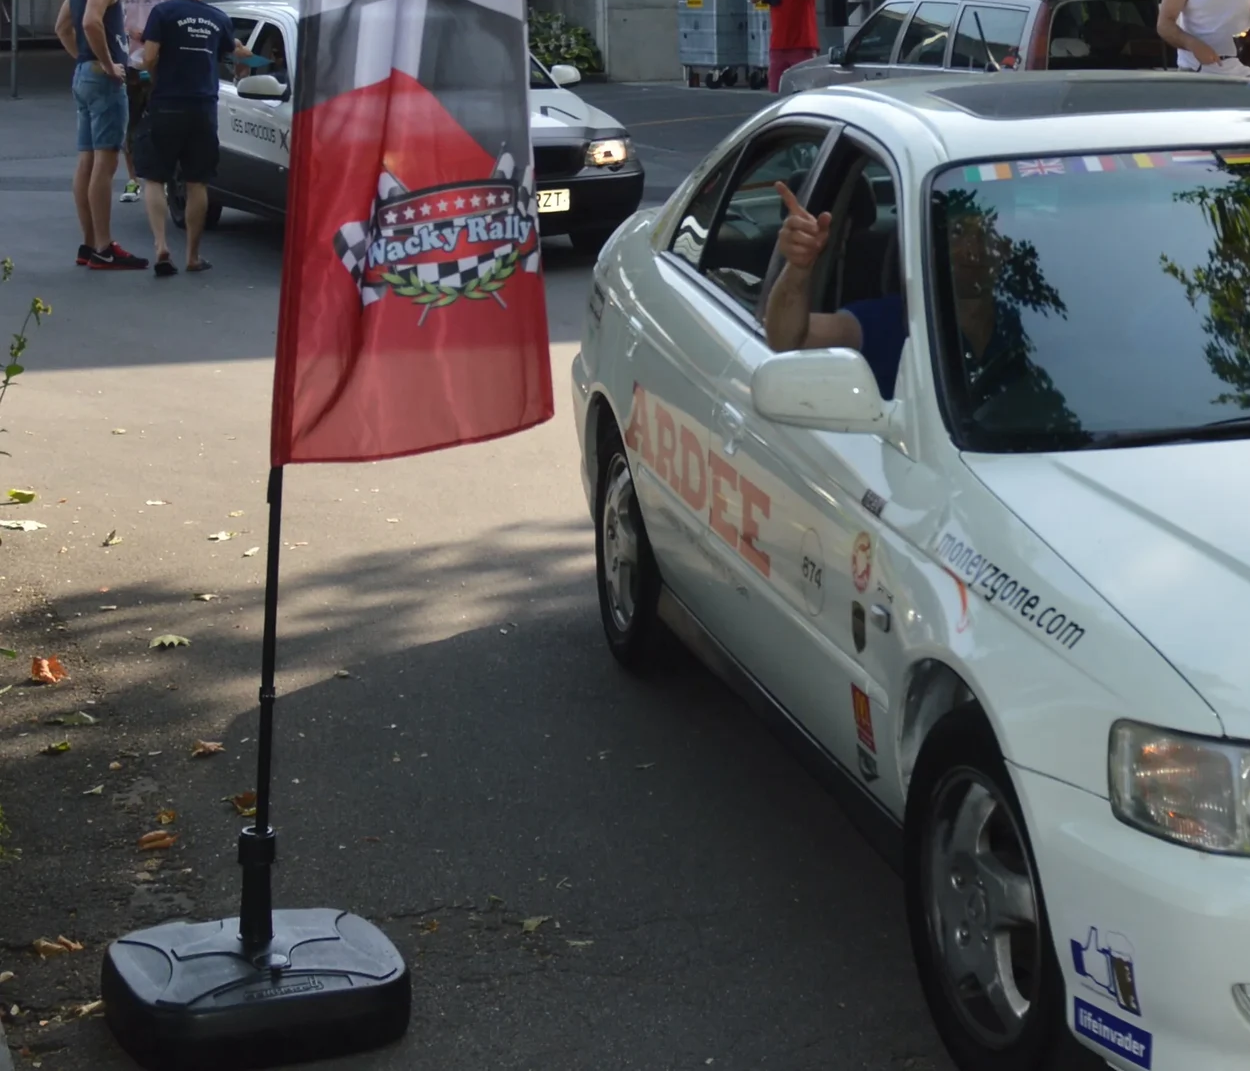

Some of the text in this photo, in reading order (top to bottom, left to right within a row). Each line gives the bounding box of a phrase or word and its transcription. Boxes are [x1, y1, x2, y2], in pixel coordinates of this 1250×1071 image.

[367, 214, 533, 269] Wacky Rally
[624, 380, 771, 579] ARDEE
[935, 532, 1087, 650] moneyzgone.com
[1078, 1007, 1146, 1058] lifeinvader
